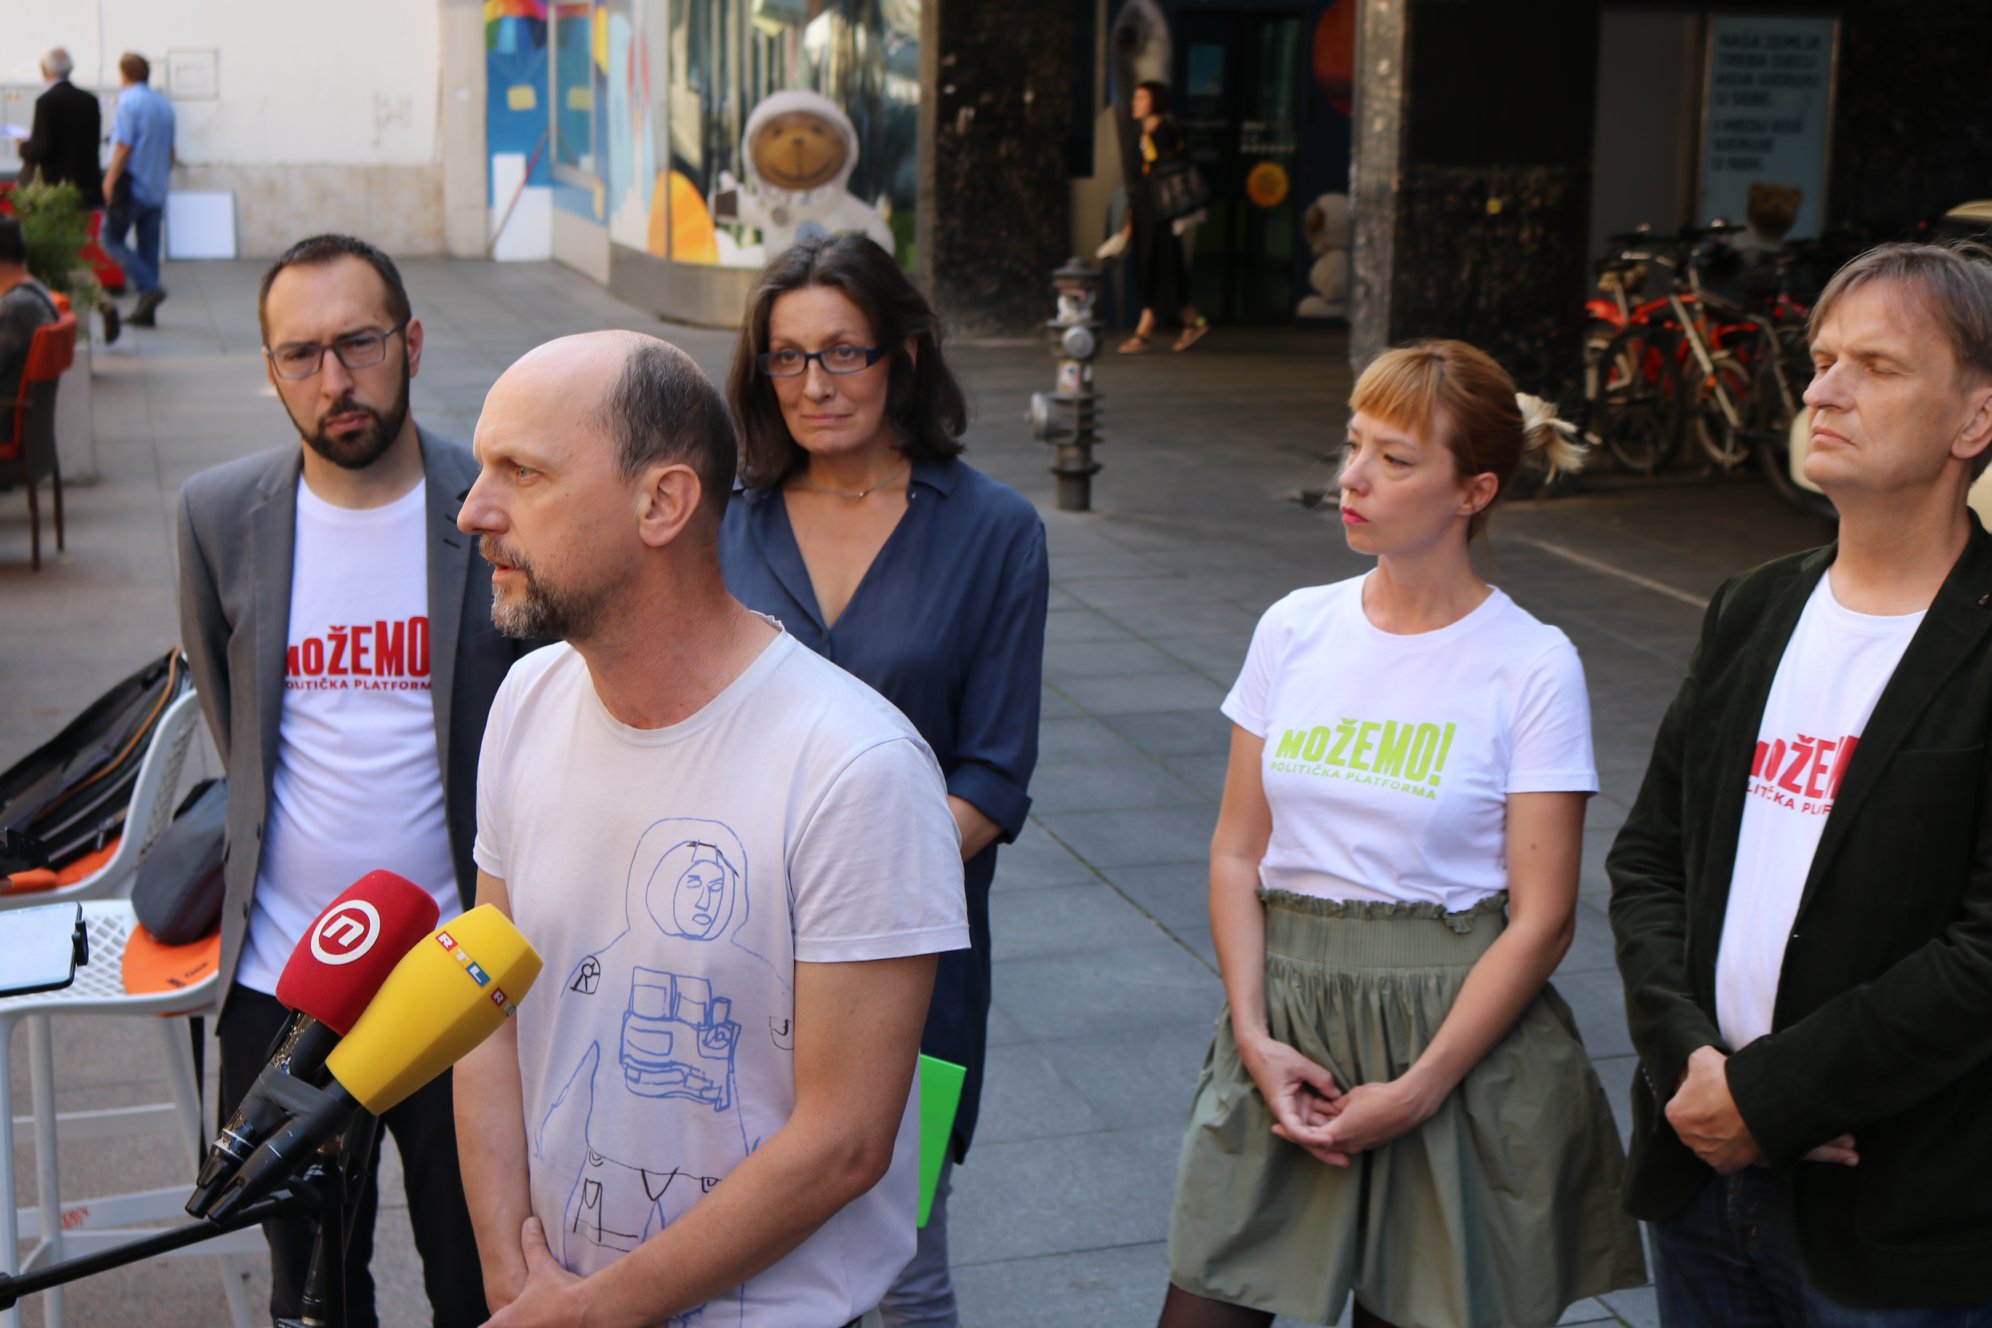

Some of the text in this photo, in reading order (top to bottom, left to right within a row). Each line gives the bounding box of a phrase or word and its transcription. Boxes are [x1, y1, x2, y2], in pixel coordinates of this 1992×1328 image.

[285, 678, 432, 691] OLITIČKA PLATFORM
[1275, 717, 1457, 787] MOŽEMO!
[1271, 761, 1436, 800] POLITIČKA PLATFORMA
[437, 932, 486, 985] RTL
